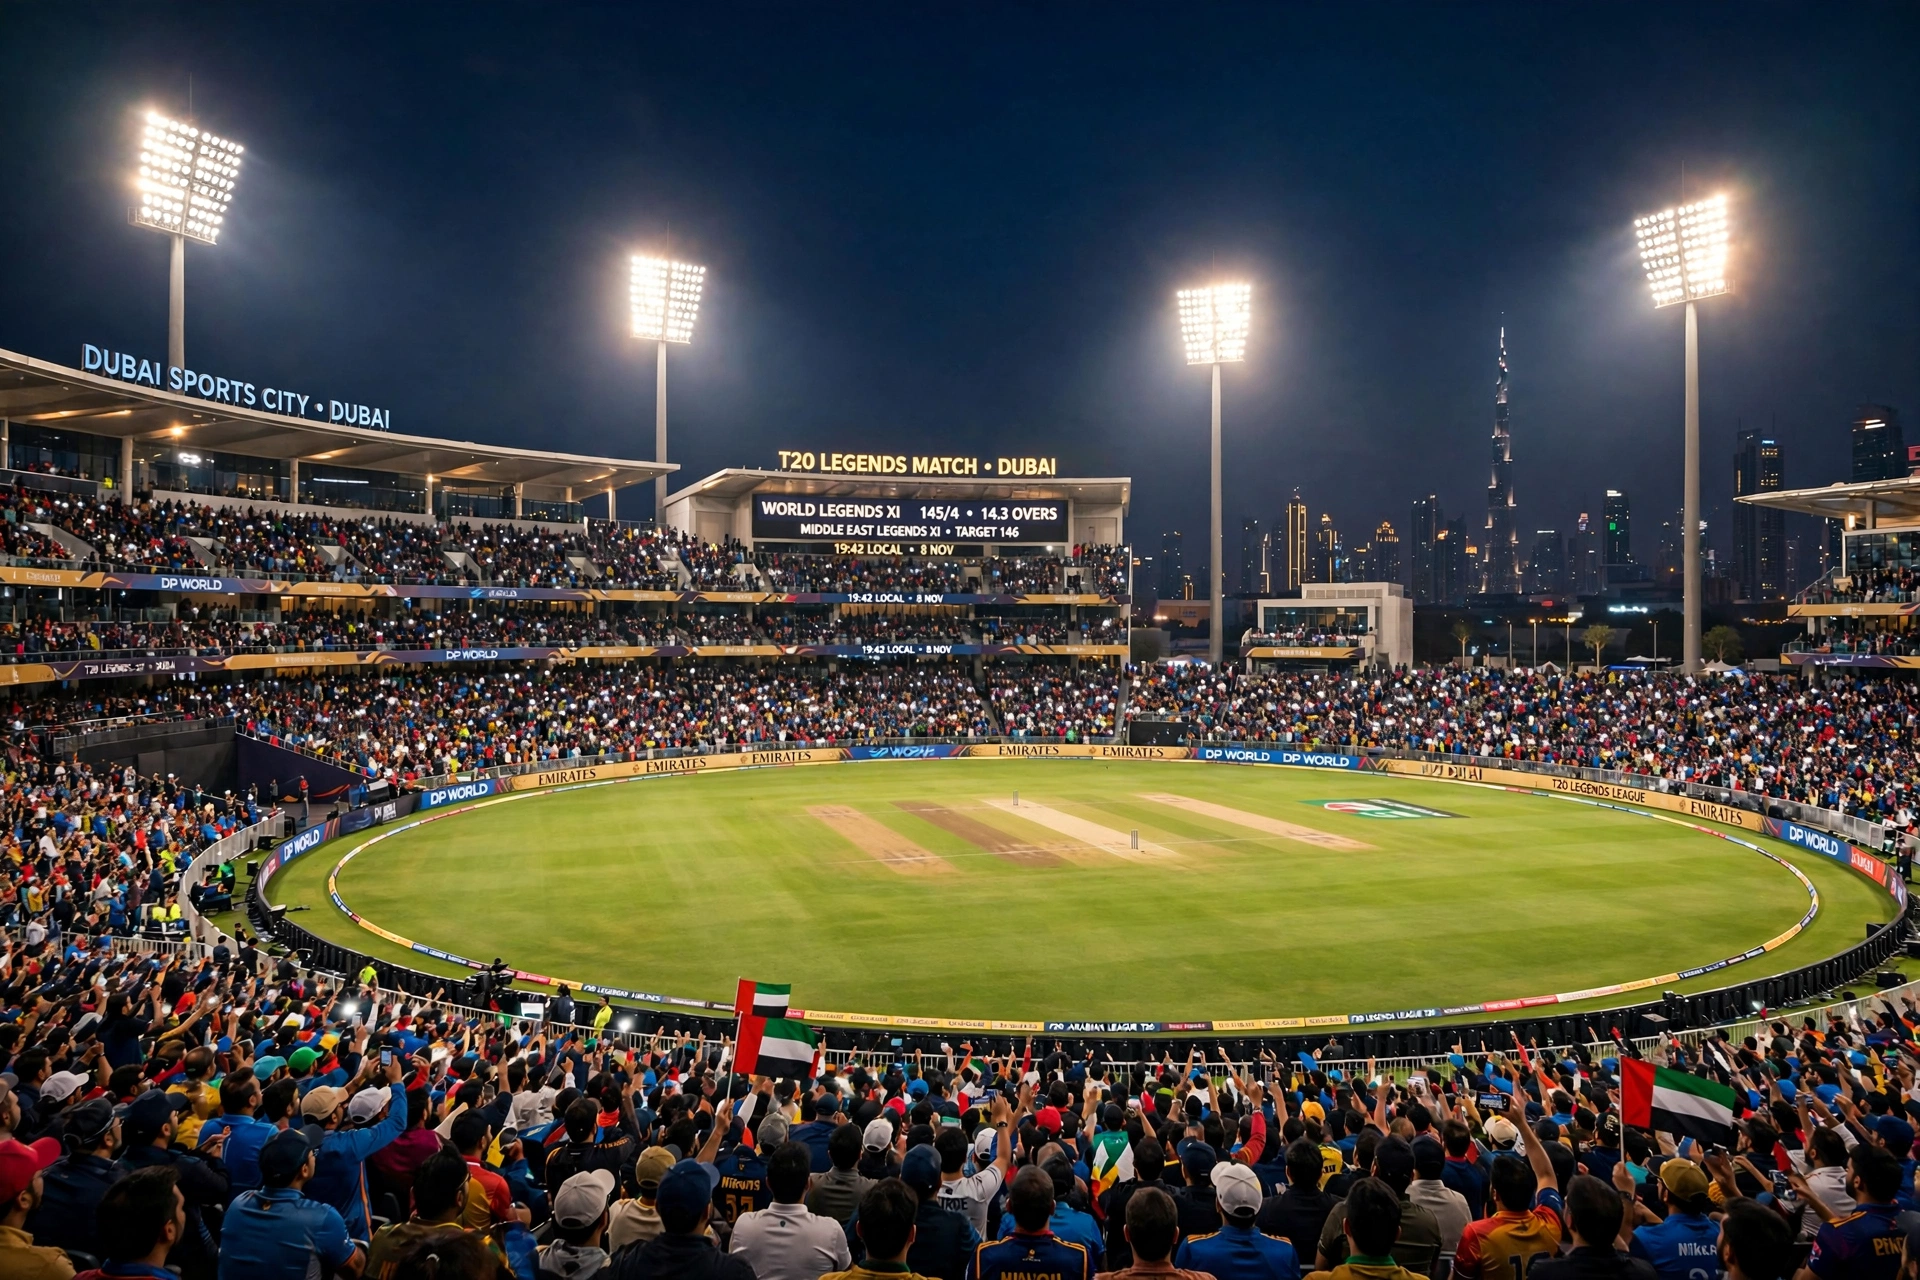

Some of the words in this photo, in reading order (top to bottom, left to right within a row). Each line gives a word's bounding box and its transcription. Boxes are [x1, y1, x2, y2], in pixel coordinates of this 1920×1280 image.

[82, 344, 161, 386] DUBAI
[168, 366, 256, 406] SPORTS
[262, 387, 310, 416] CITY
[329, 400, 389, 430] DUBAI
[779, 451, 815, 470] T20
[820, 454, 906, 474] LEGENDS
[912, 457, 977, 475] MATCH
[998, 458, 1056, 476] DUBAI
[762, 501, 816, 516] WORLD
[820, 503, 883, 518] LEGENDS
[886, 505, 900, 518] XI
[920, 505, 960, 521] 145/4
[981, 507, 1008, 520] 14.3
[1012, 507, 1057, 520] OVERS
[801, 523, 844, 535] MIDDLE
[847, 525, 874, 536] EAST
[877, 525, 927, 537] LEGENDS
[929, 527, 941, 537] XI
[955, 526, 997, 537] TARGET
[1000, 527, 1019, 538] 146
[834, 543, 864, 554] 19:42
[867, 543, 903, 555] LOCAL
[920, 544, 926, 555] 8
[930, 544, 954, 555] NOV
[161, 578, 178, 589] DP
[180, 579, 223, 591] WORLD
[847, 594, 873, 603] 19:42
[875, 594, 905, 604] LOCAL
[924, 594, 944, 604] NOV
[446, 650, 461, 660] DP
[462, 650, 498, 660] WORLD
[887, 645, 915, 654] LOCAL
[933, 645, 952, 654] NOV
[752, 751, 811, 764] EMIRATES
[999, 745, 1059, 755] EMIRATES
[1103, 746, 1164, 758] EMIRATES
[1205, 750, 1223, 759] DP
[1225, 750, 1270, 762] WORLD
[646, 758, 707, 773] EMIRATES
[1283, 753, 1301, 763] DP
[1303, 755, 1350, 767] WORLD
[538, 768, 596, 786] EMIRATES
[430, 789, 447, 806] DP
[448, 782, 489, 801] WORLD
[1552, 778, 1568, 791] T20
[1570, 781, 1610, 797] LEGENDS
[1612, 785, 1645, 803] LEAGUE
[1691, 801, 1743, 827] EMIRATES
[284, 842, 294, 862] DP
[294, 829, 320, 849] WORLD
[1789, 825, 1804, 842] DP
[1805, 830, 1839, 856] WORLD
